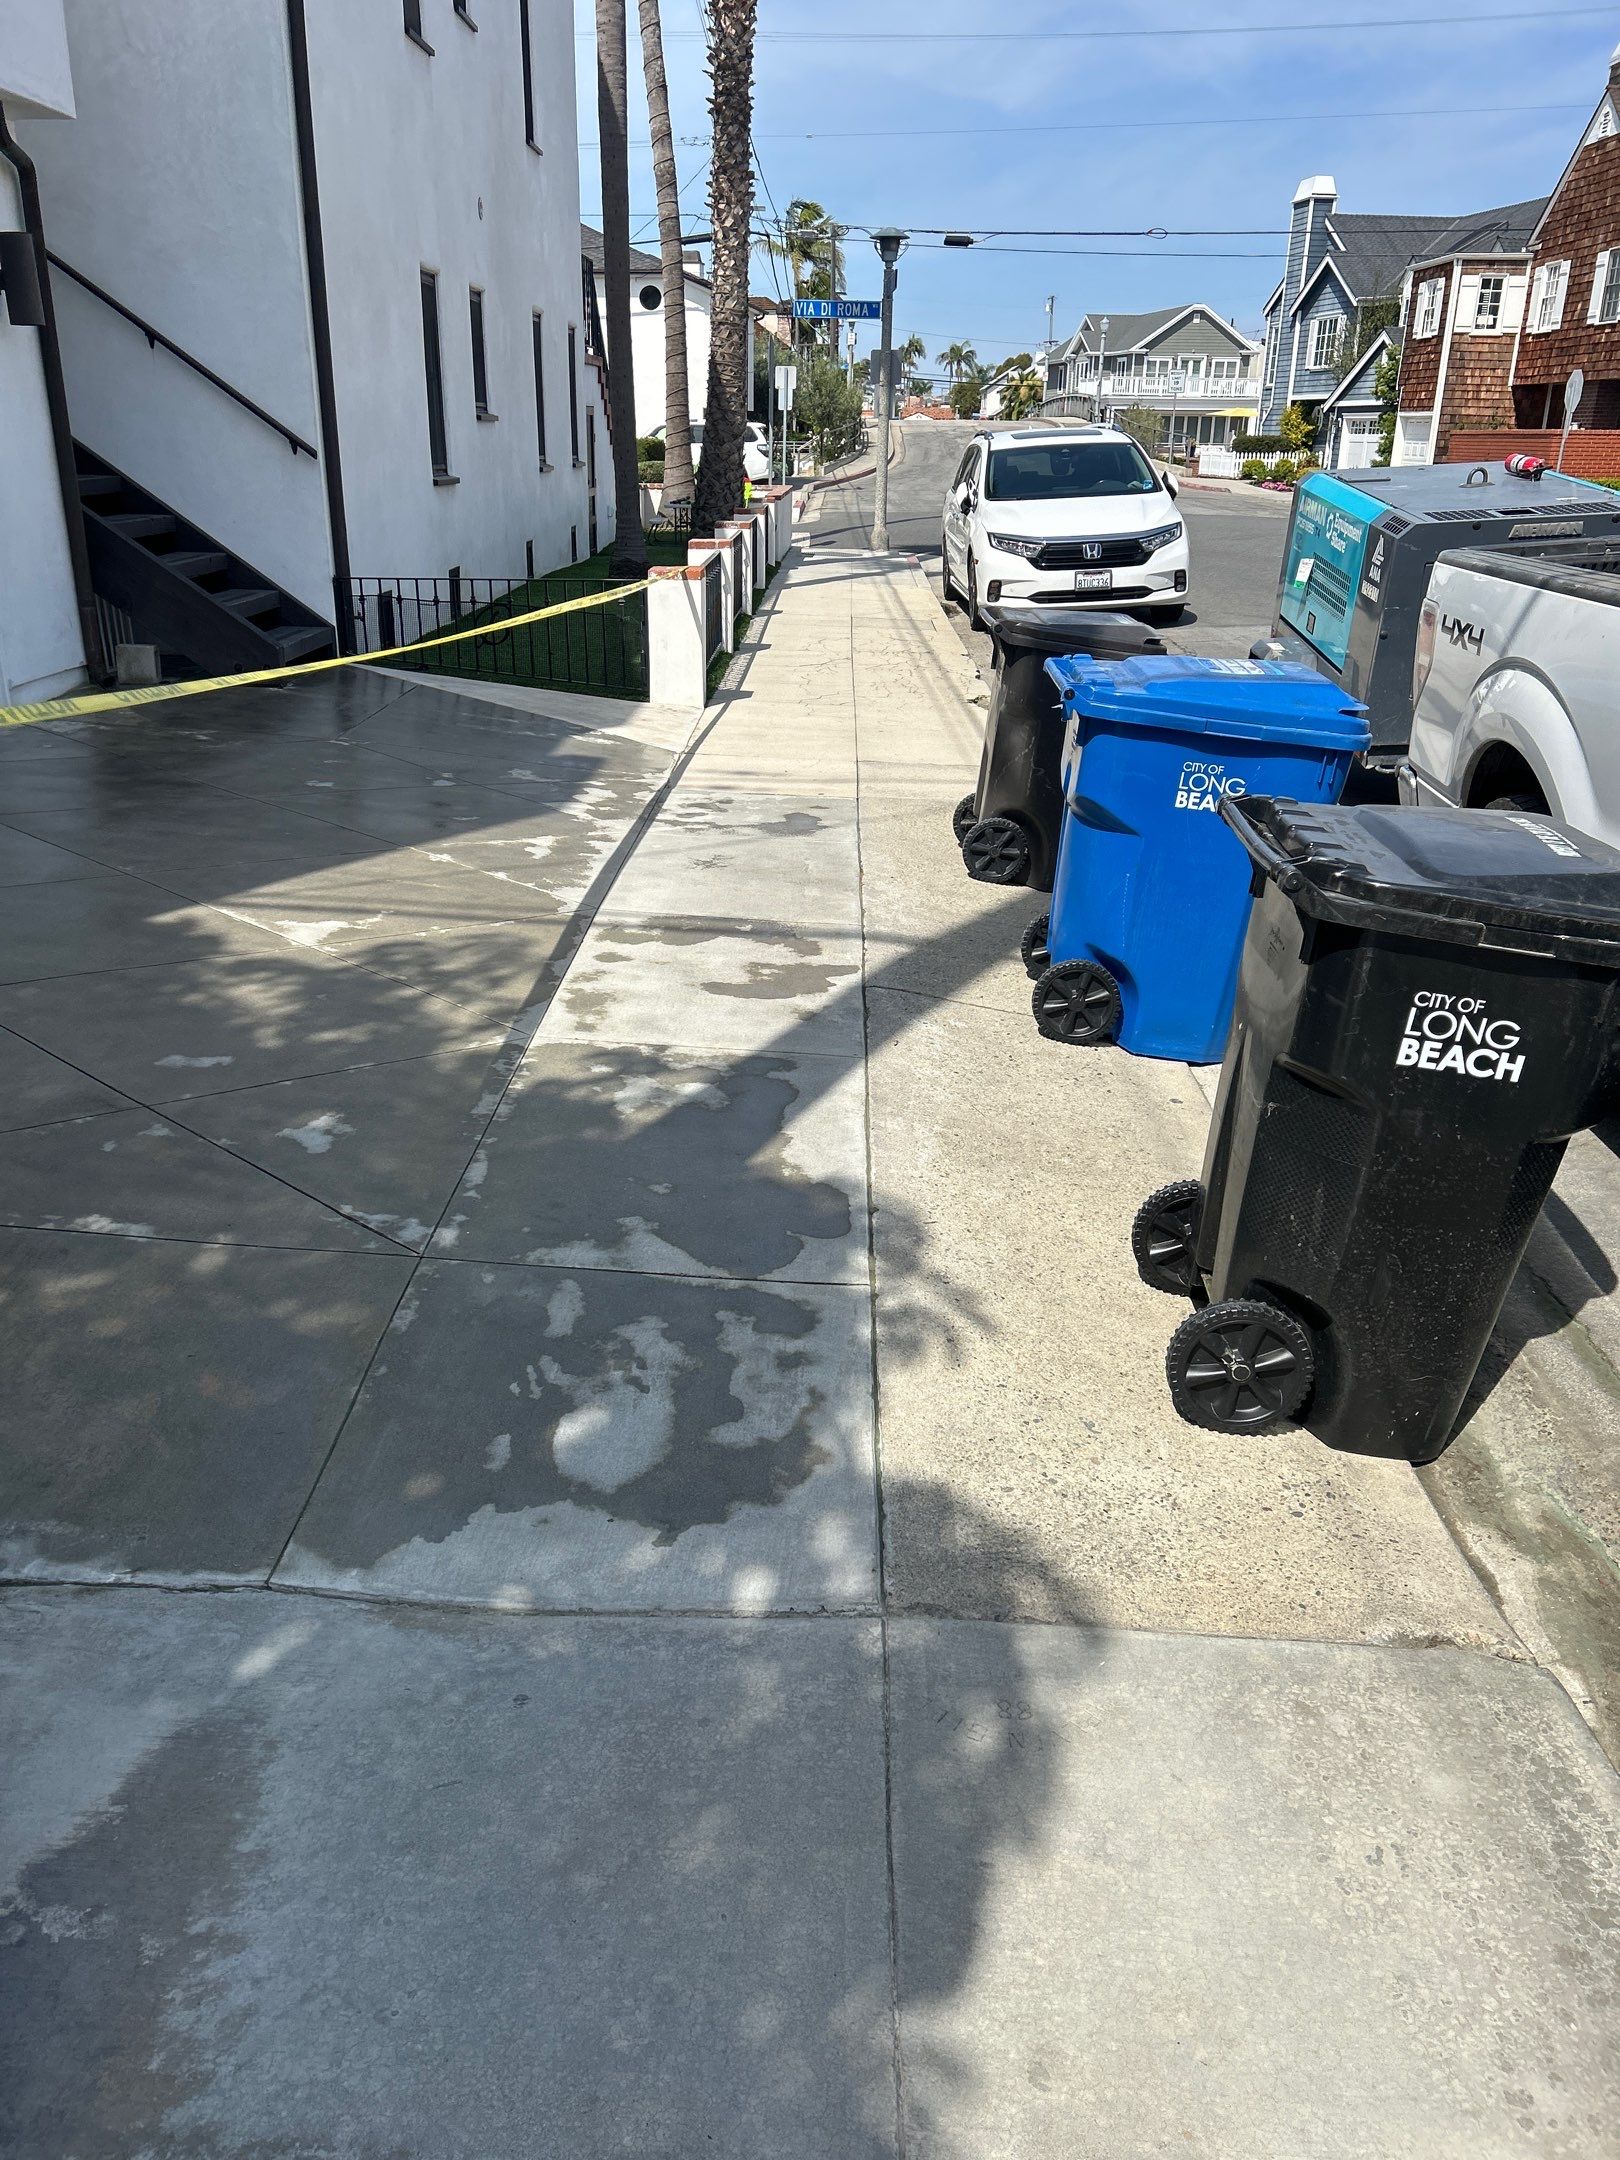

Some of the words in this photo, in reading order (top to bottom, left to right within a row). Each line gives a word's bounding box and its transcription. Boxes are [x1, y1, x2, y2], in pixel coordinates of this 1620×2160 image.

[796, 302, 815, 316] VIA
[821, 303, 831, 316] DI
[837, 303, 869, 317] ROMA
[1299, 494, 1328, 527] AIRMAN
[1508, 520, 1584, 538] AIRMAN
[1183, 761, 1207, 773] CITY
[1208, 764, 1225, 775] OF
[1179, 772, 1246, 797] LONG
[1174, 790, 1219, 813] BEA
[1414, 991, 1457, 1010] CITY
[1457, 997, 1487, 1014] OF
[1404, 1007, 1521, 1050] LONG
[1395, 1037, 1526, 1083] BEACH
